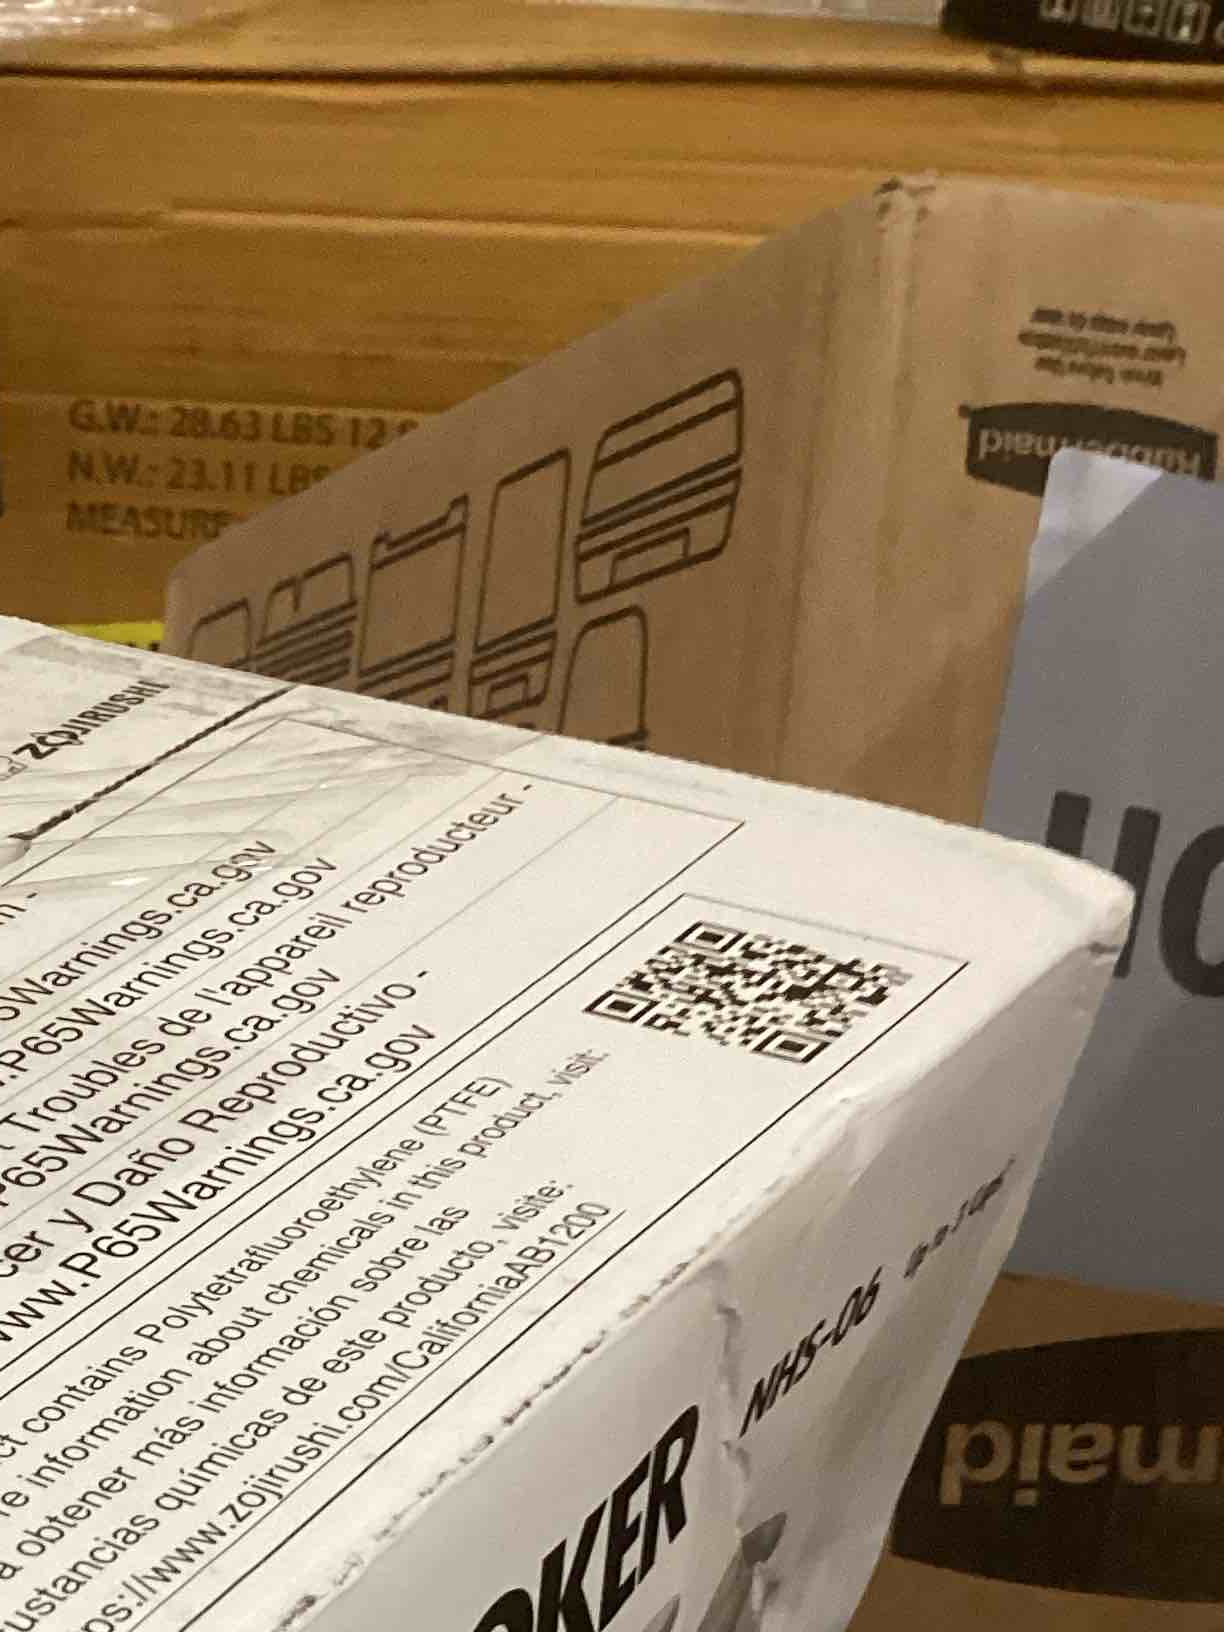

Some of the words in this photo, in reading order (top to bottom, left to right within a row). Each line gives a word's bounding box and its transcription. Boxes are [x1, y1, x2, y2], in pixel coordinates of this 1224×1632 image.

[157, 1008, 212, 1036] de
[194, 912, 353, 1005] l'appareil
[340, 792, 523, 913] reproducteur
[17, 1368, 193, 1488] information
[186, 1306, 273, 1365] about
[265, 1211, 396, 1304] chemicals
[378, 1191, 423, 1210] in
[408, 1157, 467, 1189] this
[457, 1092, 562, 1158] product,
[546, 1048, 610, 1085] visit:
[22, 1346, 148, 1432] contains
[134, 1138, 425, 1343] Polytetrafluoroethylene
[413, 1076, 512, 1135] (PTFE)
[48, 1208, 95, 1233] y
[72, 1137, 196, 1207] Daño
[178, 983, 417, 1133] Reproductivo
[16, 1465, 137, 1556] obtener
[132, 1416, 205, 1466] más
[188, 1295, 359, 1413] información
[350, 1237, 429, 1292] sobre
[414, 1206, 469, 1235] las
[155, 1408, 289, 1510] químicas
[282, 1377, 327, 1405] de
[322, 1328, 387, 1373] este
[378, 1239, 507, 1328] producto,
[492, 1179, 573, 1229] visite:
[740, 1265, 885, 1439] NHS-06
